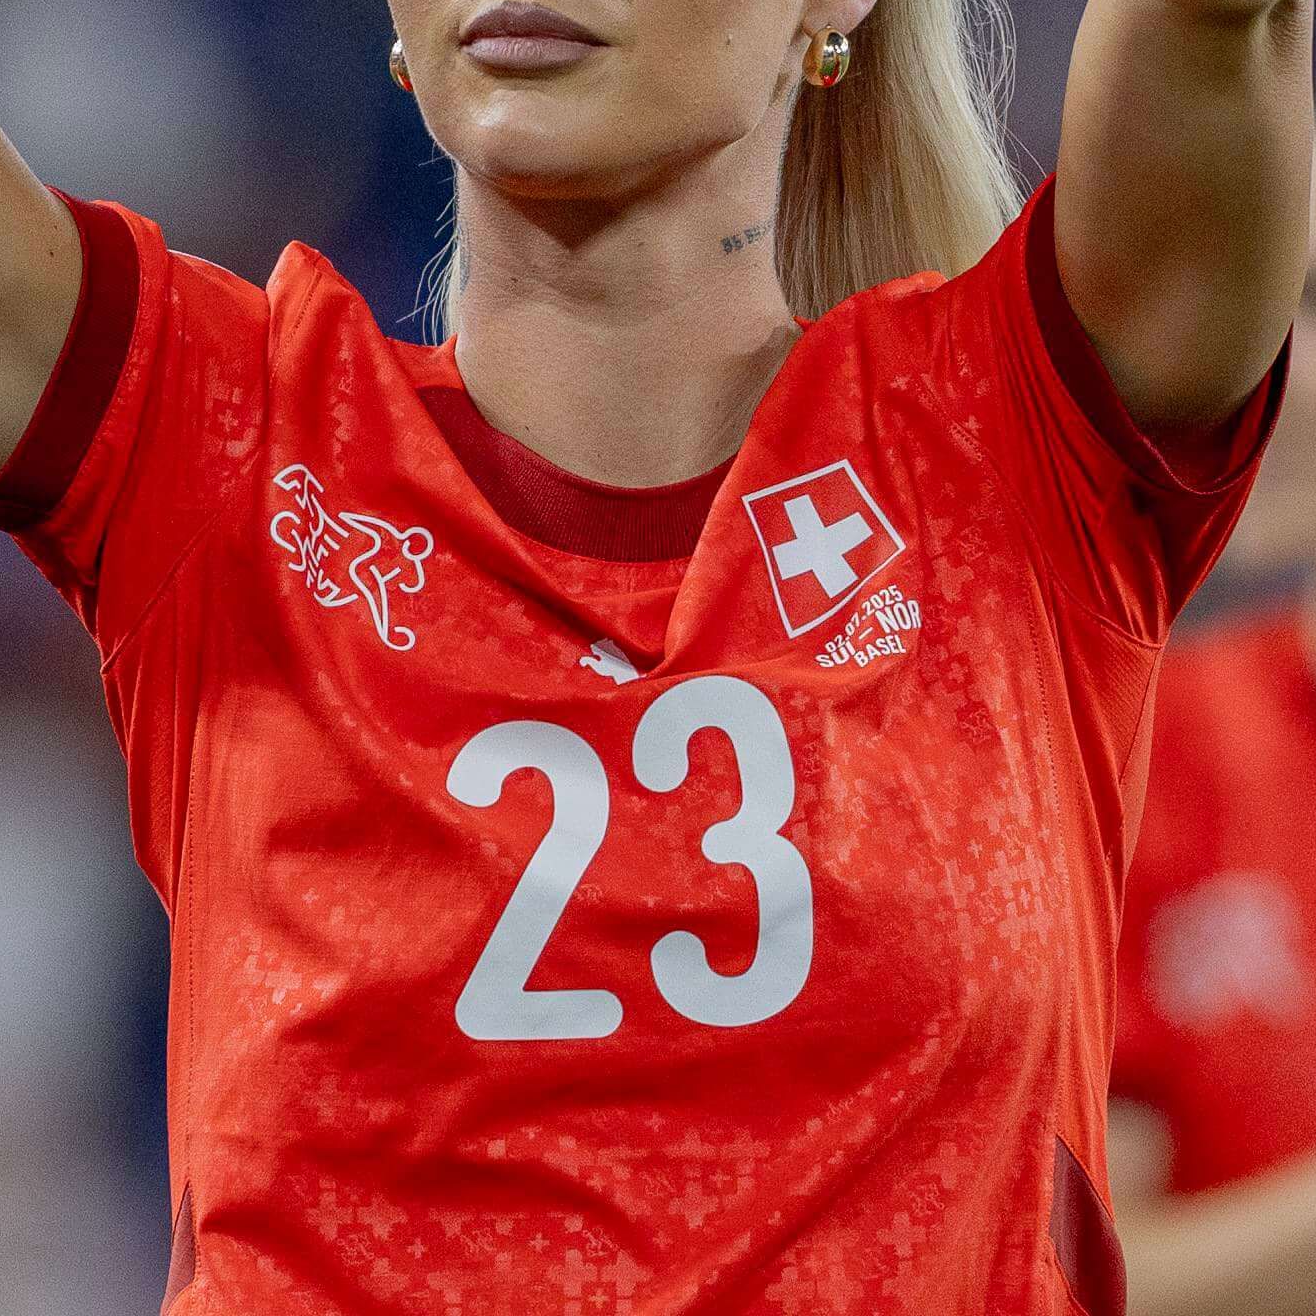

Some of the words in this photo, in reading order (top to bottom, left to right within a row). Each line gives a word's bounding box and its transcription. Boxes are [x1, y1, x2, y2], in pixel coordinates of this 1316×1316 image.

[815, 640, 856, 668] SUI
[875, 600, 922, 633] NOR
[825, 584, 903, 652] 02.07.2025
[854, 635, 906, 668] BASEL
[446, 675, 813, 1041] 23
